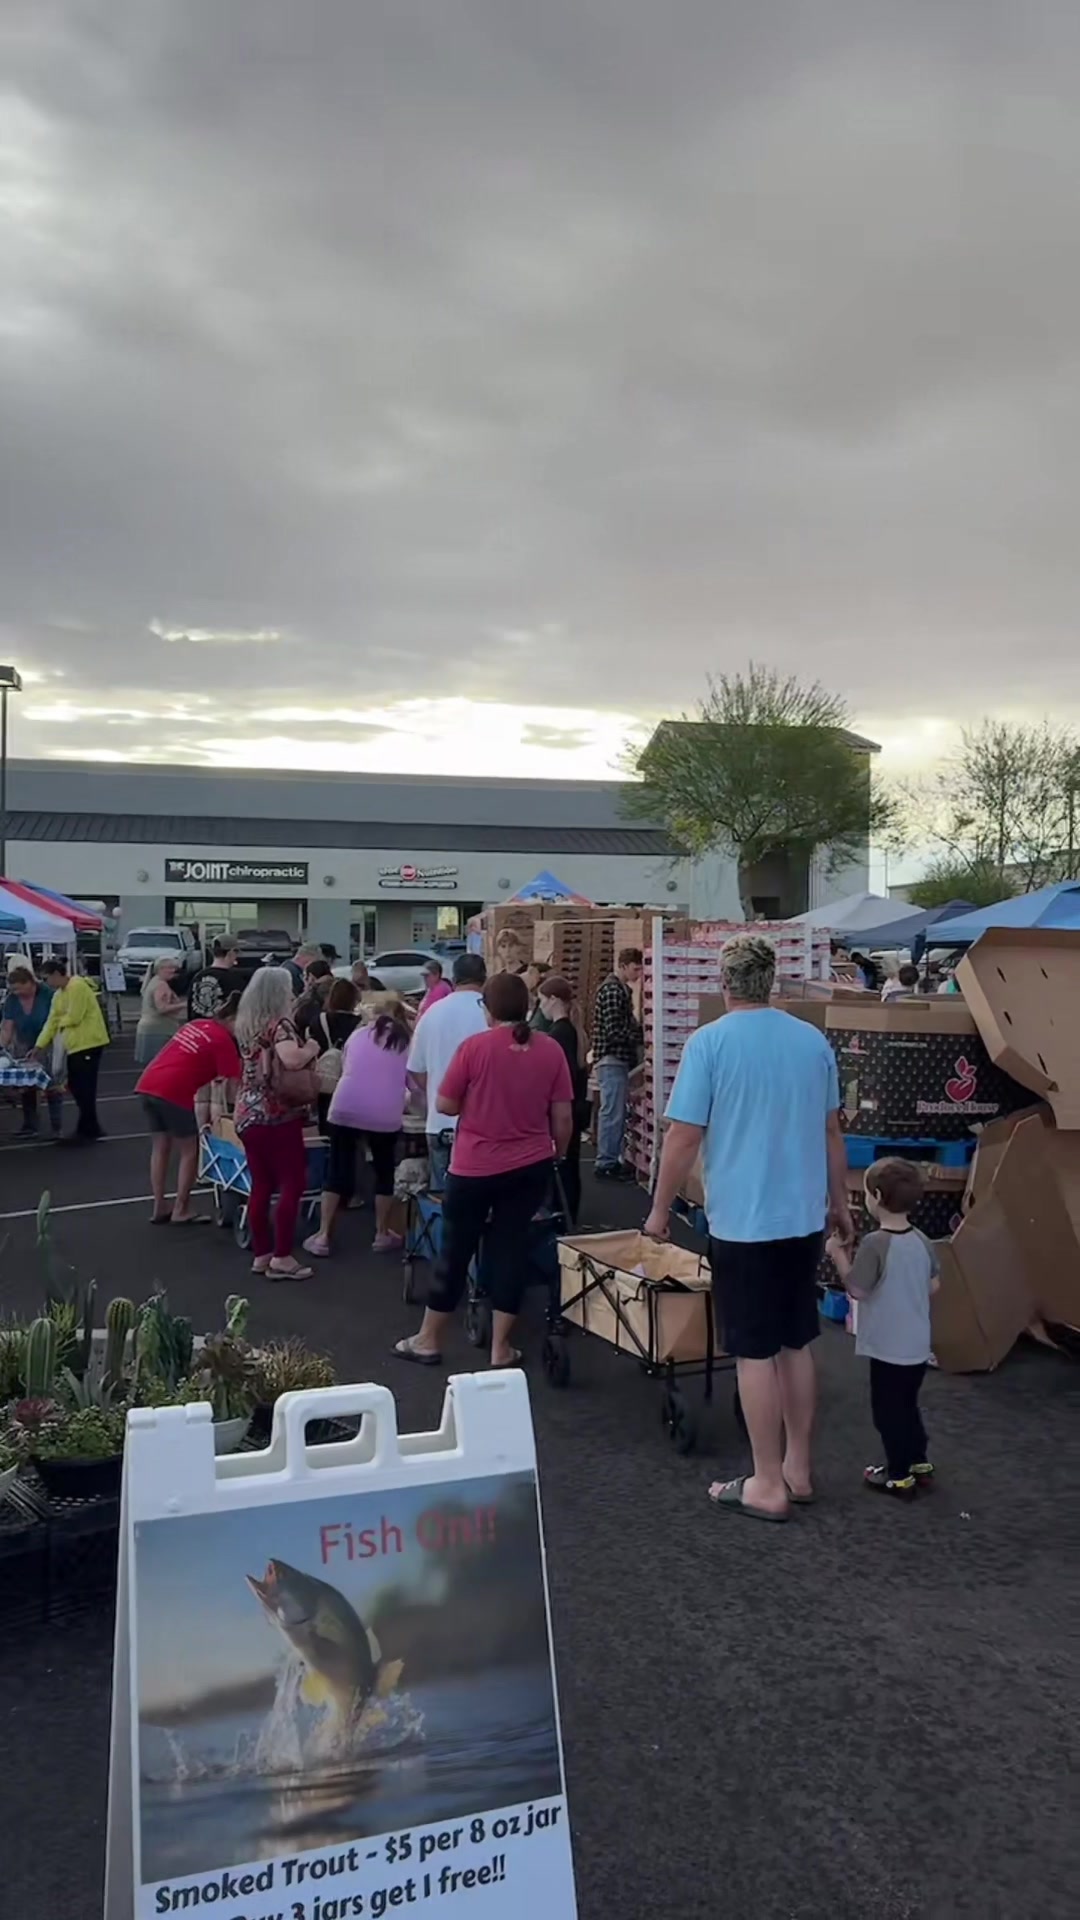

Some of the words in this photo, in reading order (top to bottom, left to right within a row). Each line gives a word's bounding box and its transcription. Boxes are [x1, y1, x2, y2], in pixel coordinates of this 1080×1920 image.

[184, 862, 230, 879] JOINT
[229, 865, 305, 878] chiropractic
[320, 1515, 402, 1564] Fish
[416, 1505, 497, 1552] On!!
[155, 1863, 274, 1914] Smoked
[281, 1847, 359, 1887] Trout
[385, 1832, 412, 1864] $5
[419, 1827, 463, 1862] per
[470, 1818, 485, 1843] 8
[492, 1815, 520, 1838] oz
[524, 1805, 561, 1836] jar
[291, 1902, 305, 1920] 3
[314, 1895, 363, 1920] jars
[370, 1878, 417, 1919] get
[438, 1854, 505, 1895] free!!
